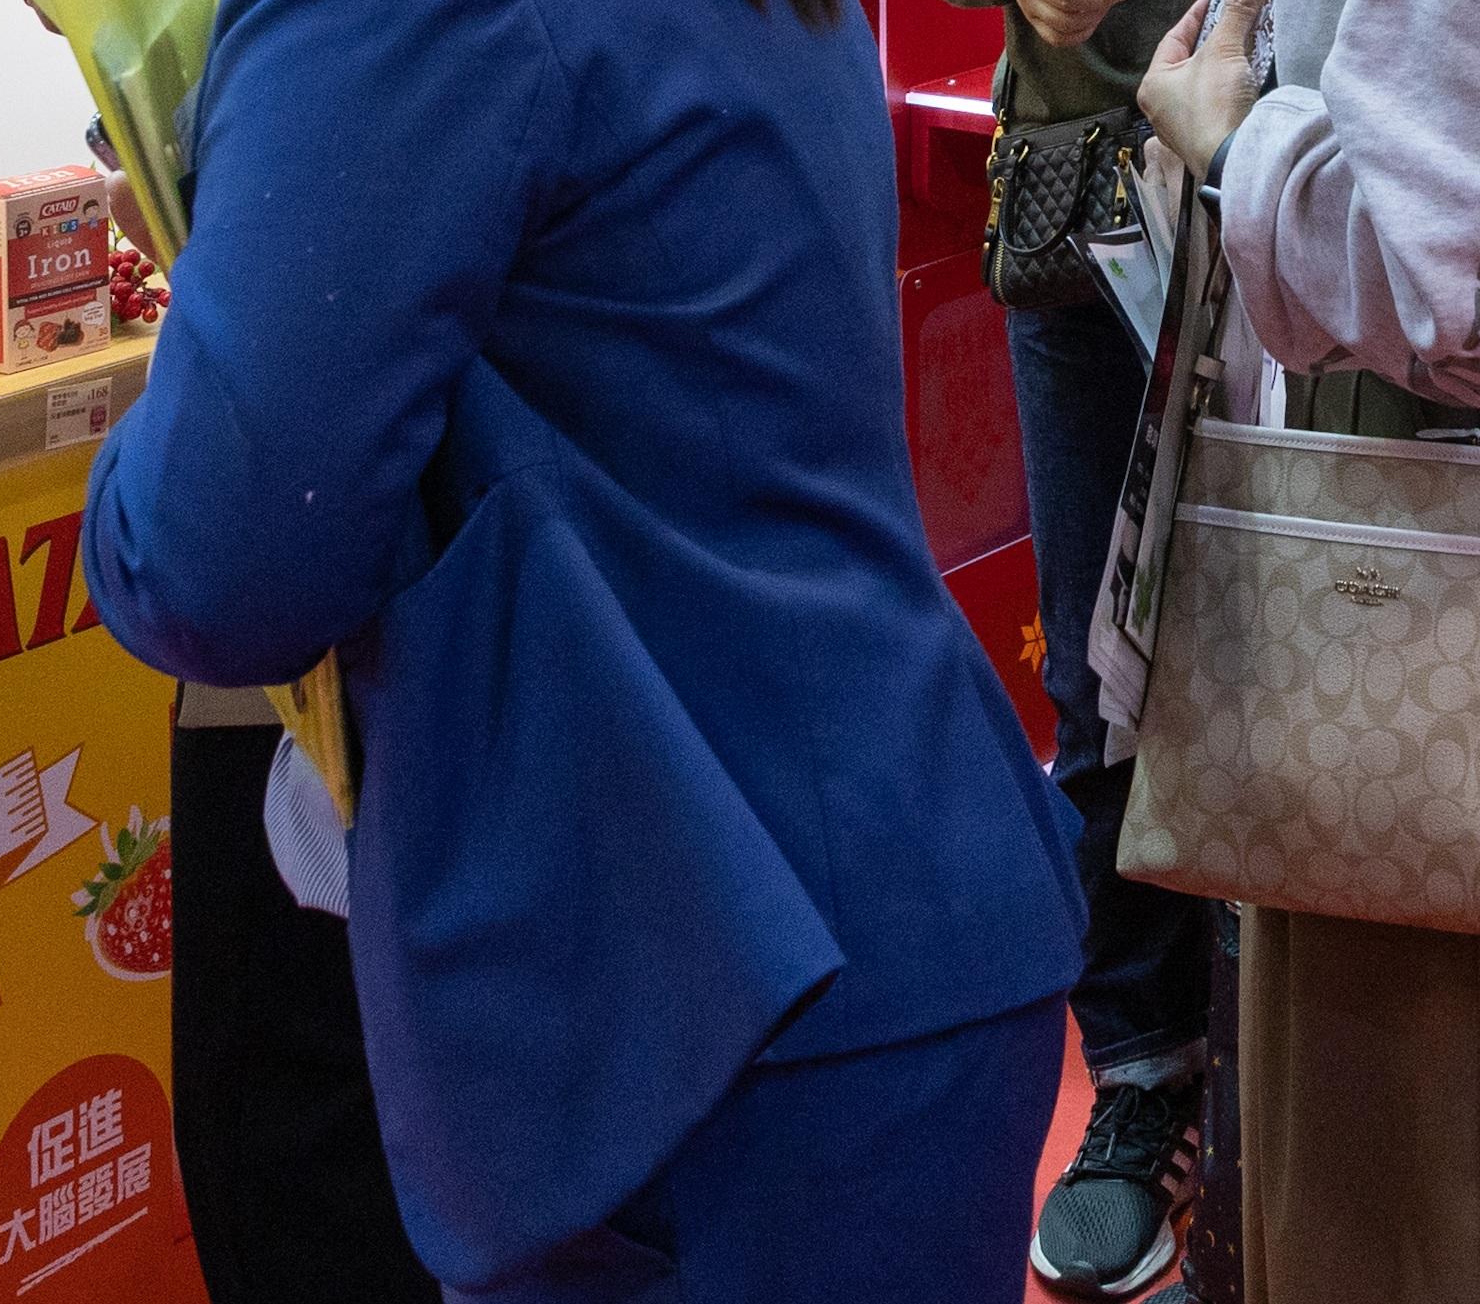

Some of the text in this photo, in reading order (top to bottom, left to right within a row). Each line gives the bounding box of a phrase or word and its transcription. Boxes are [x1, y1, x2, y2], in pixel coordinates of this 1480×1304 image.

[3, 168, 75, 189] Iron
[41, 199, 76, 217] CATALO
[27, 247, 92, 279] Iron
[26, 1086, 127, 1190] 促進
